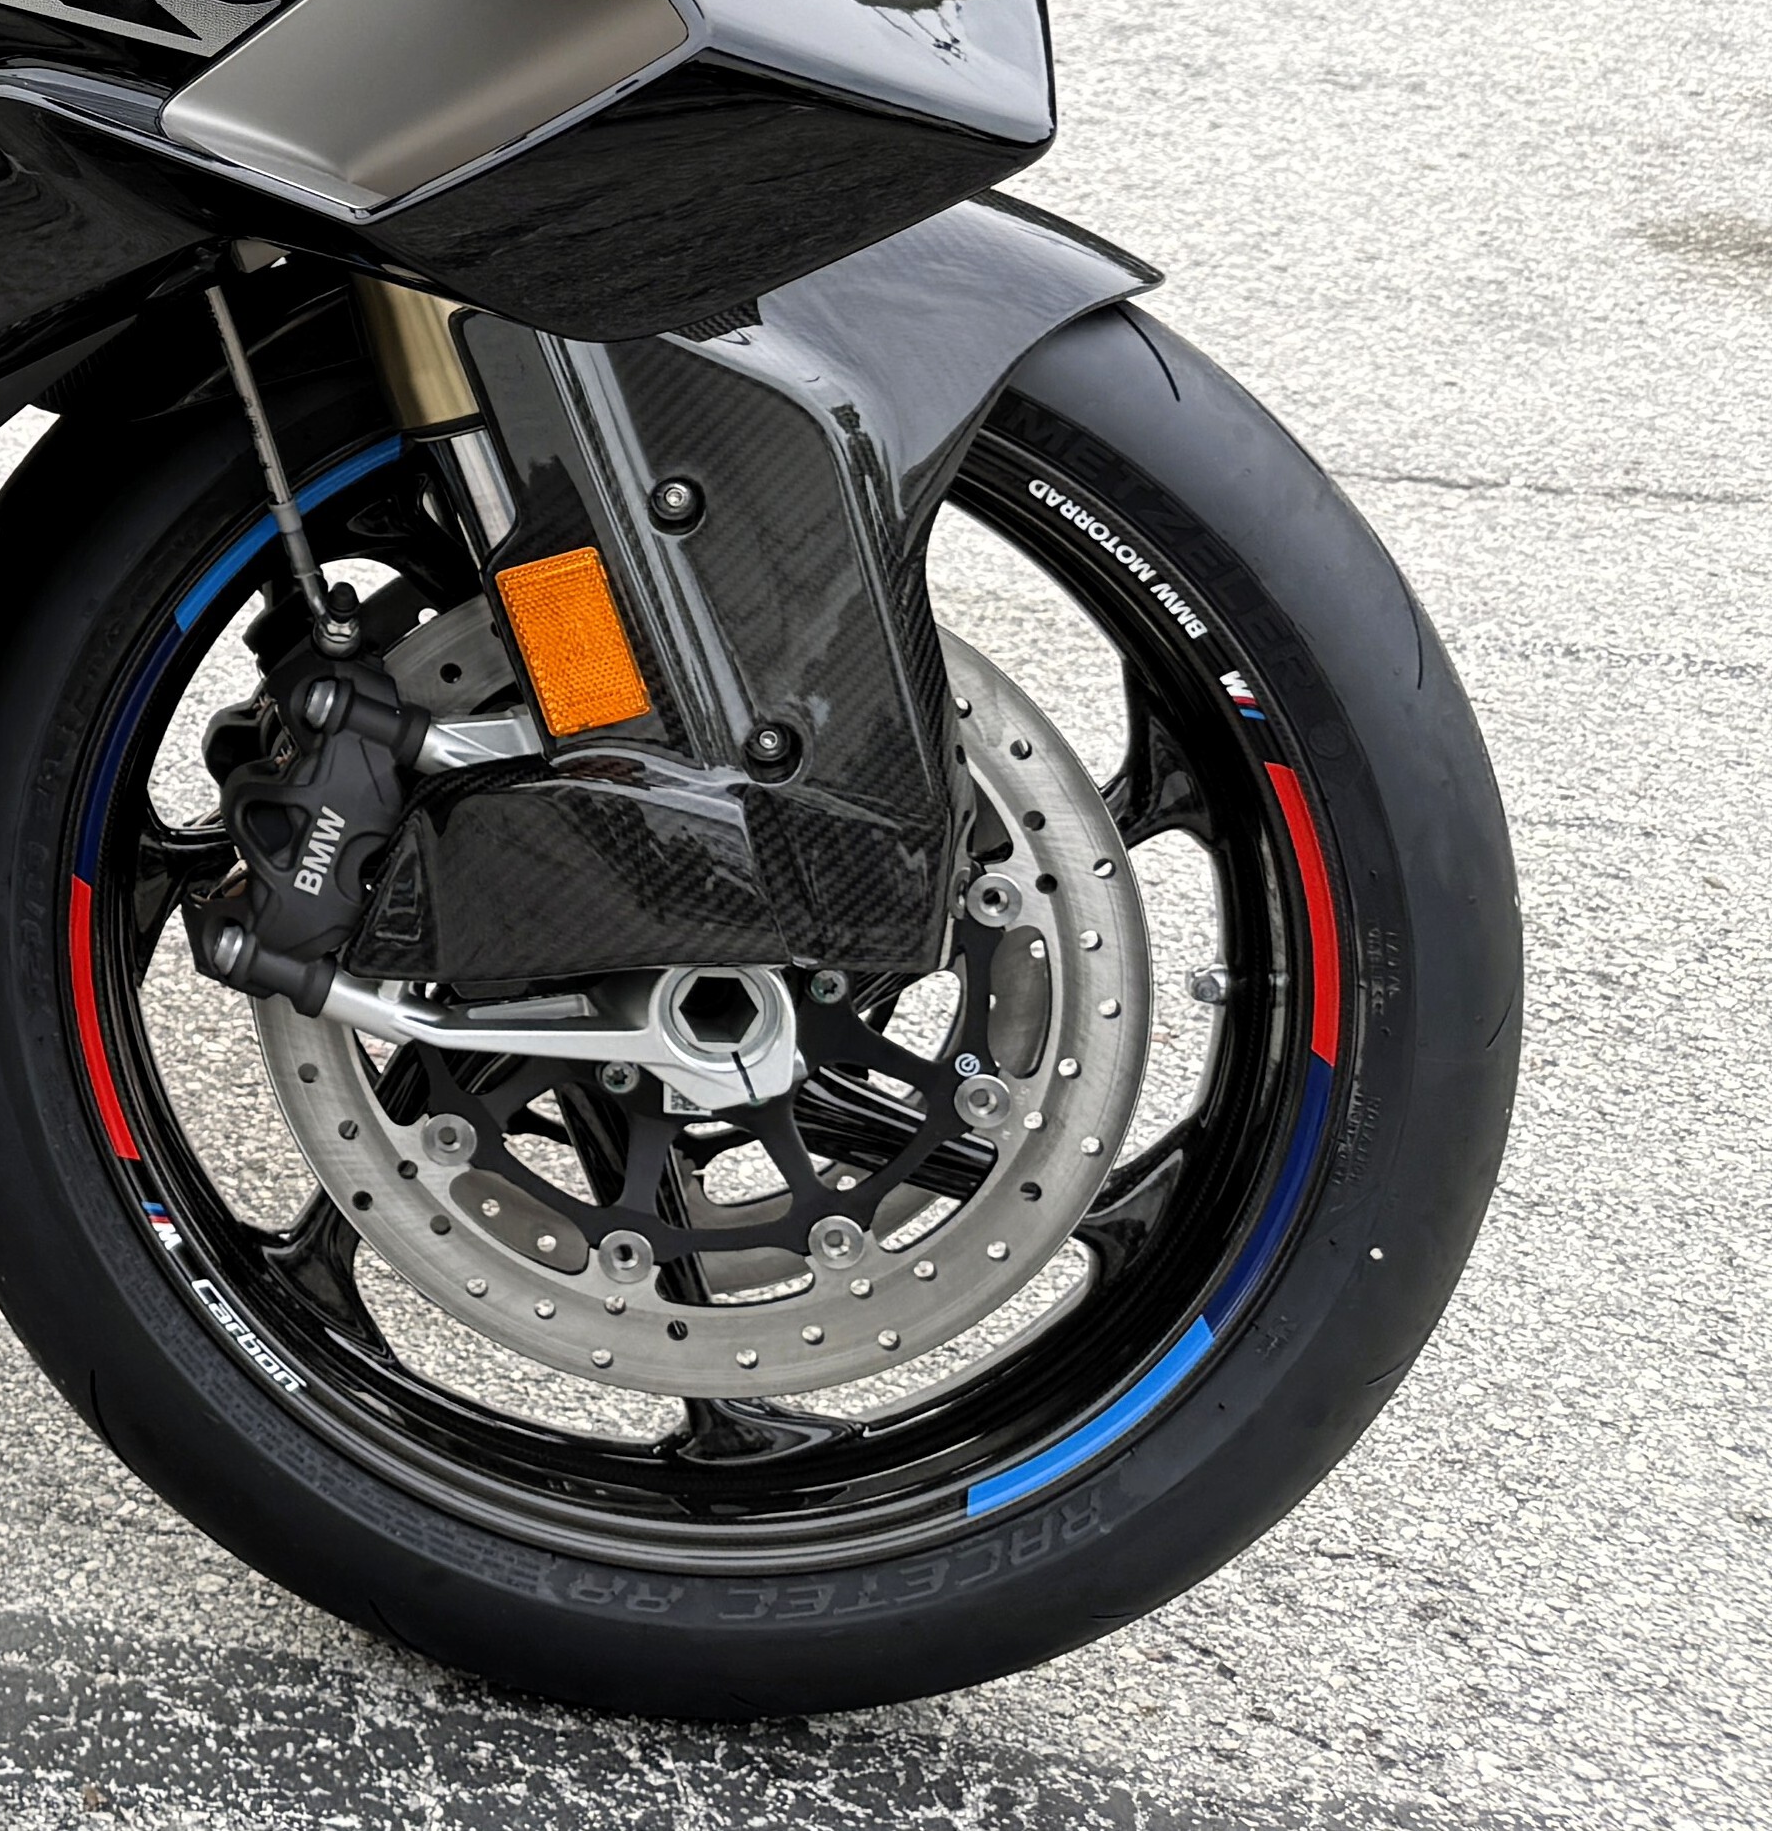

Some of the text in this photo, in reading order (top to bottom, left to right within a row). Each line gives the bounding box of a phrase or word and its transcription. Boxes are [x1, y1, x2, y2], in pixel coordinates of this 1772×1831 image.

[1028, 479, 1157, 583] MOTORRAD
[1150, 583, 1209, 640] BMW
[294, 805, 346, 897] BMW
[191, 1278, 308, 1393] Carbon
[718, 1491, 1111, 1621] RACETEC
